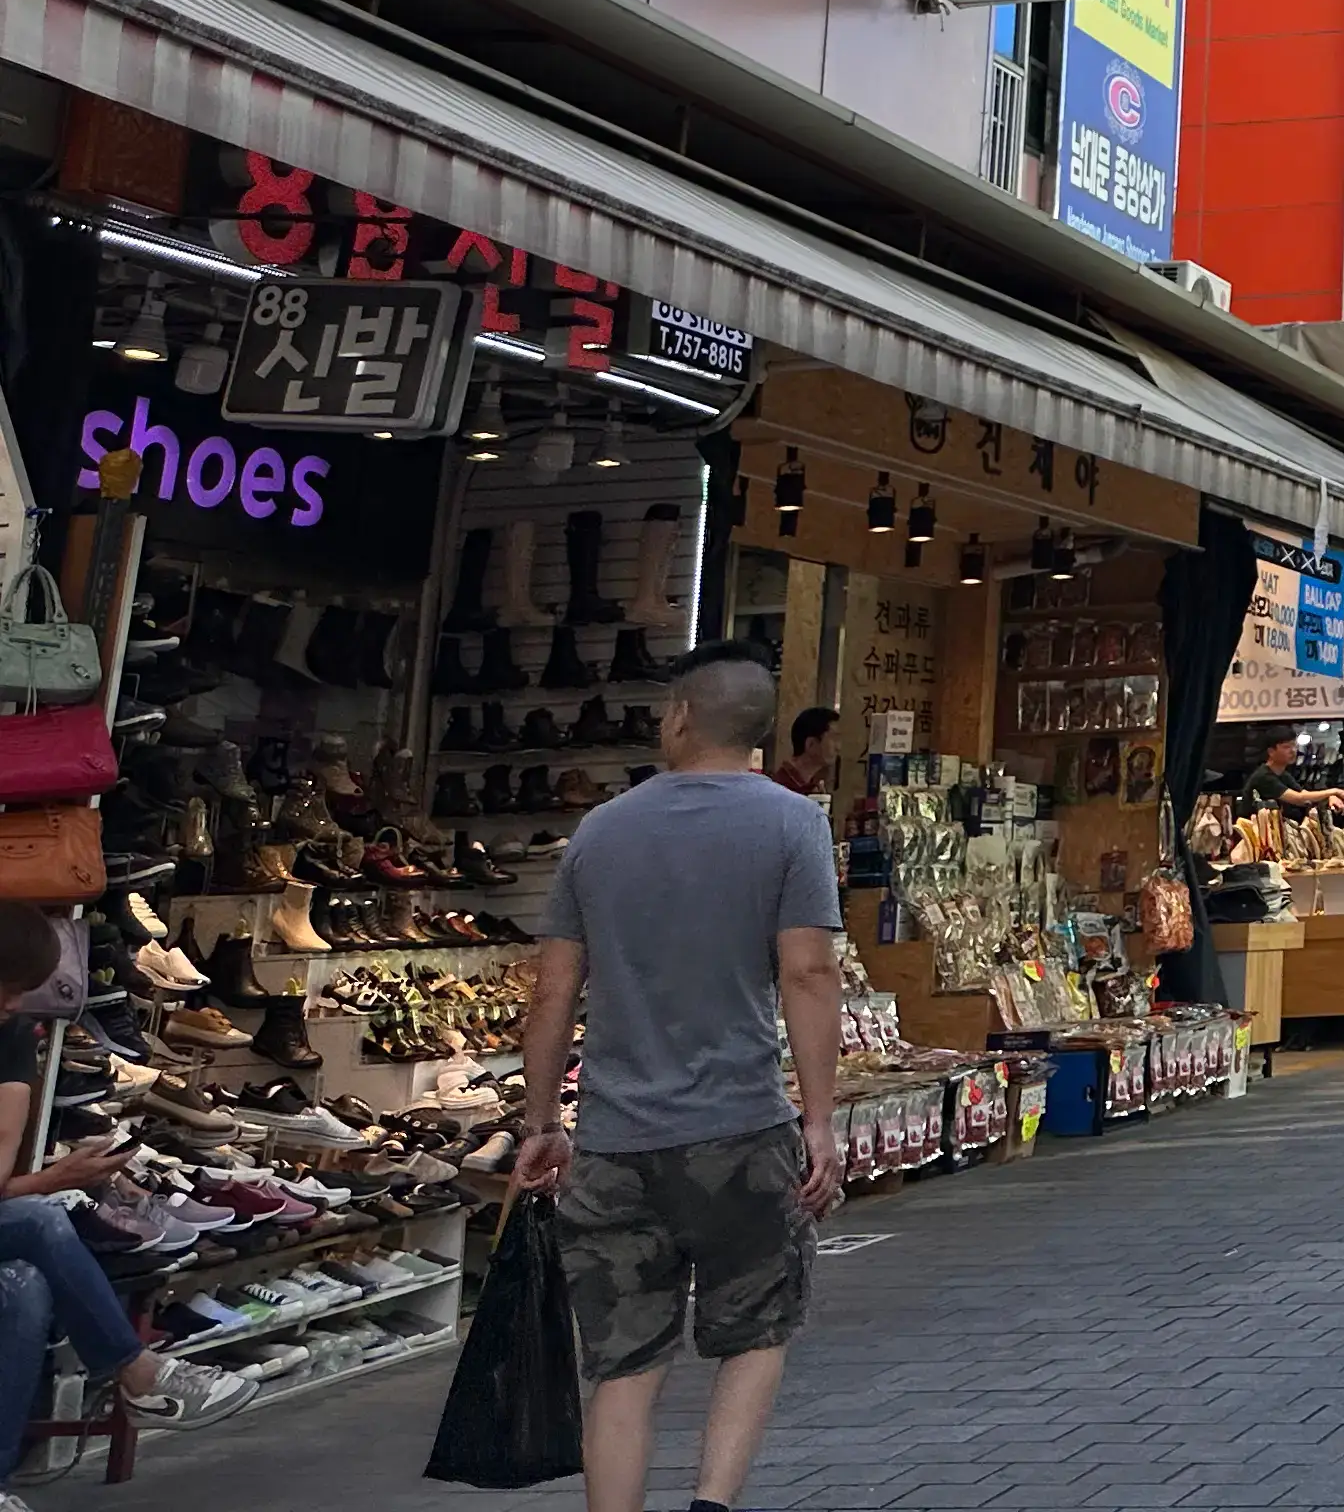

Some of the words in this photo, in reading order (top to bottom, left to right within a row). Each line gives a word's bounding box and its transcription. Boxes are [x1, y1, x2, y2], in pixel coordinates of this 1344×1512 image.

[1070, 120, 1110, 203] 남대문
[1113, 144, 1167, 233] 중앙상가
[253, 283, 308, 329] 88
[255, 306, 430, 416] 신발
[659, 329, 744, 374] T.757-8815
[77, 397, 331, 527] shoes
[862, 646, 937, 684] 슈퍼푸드
